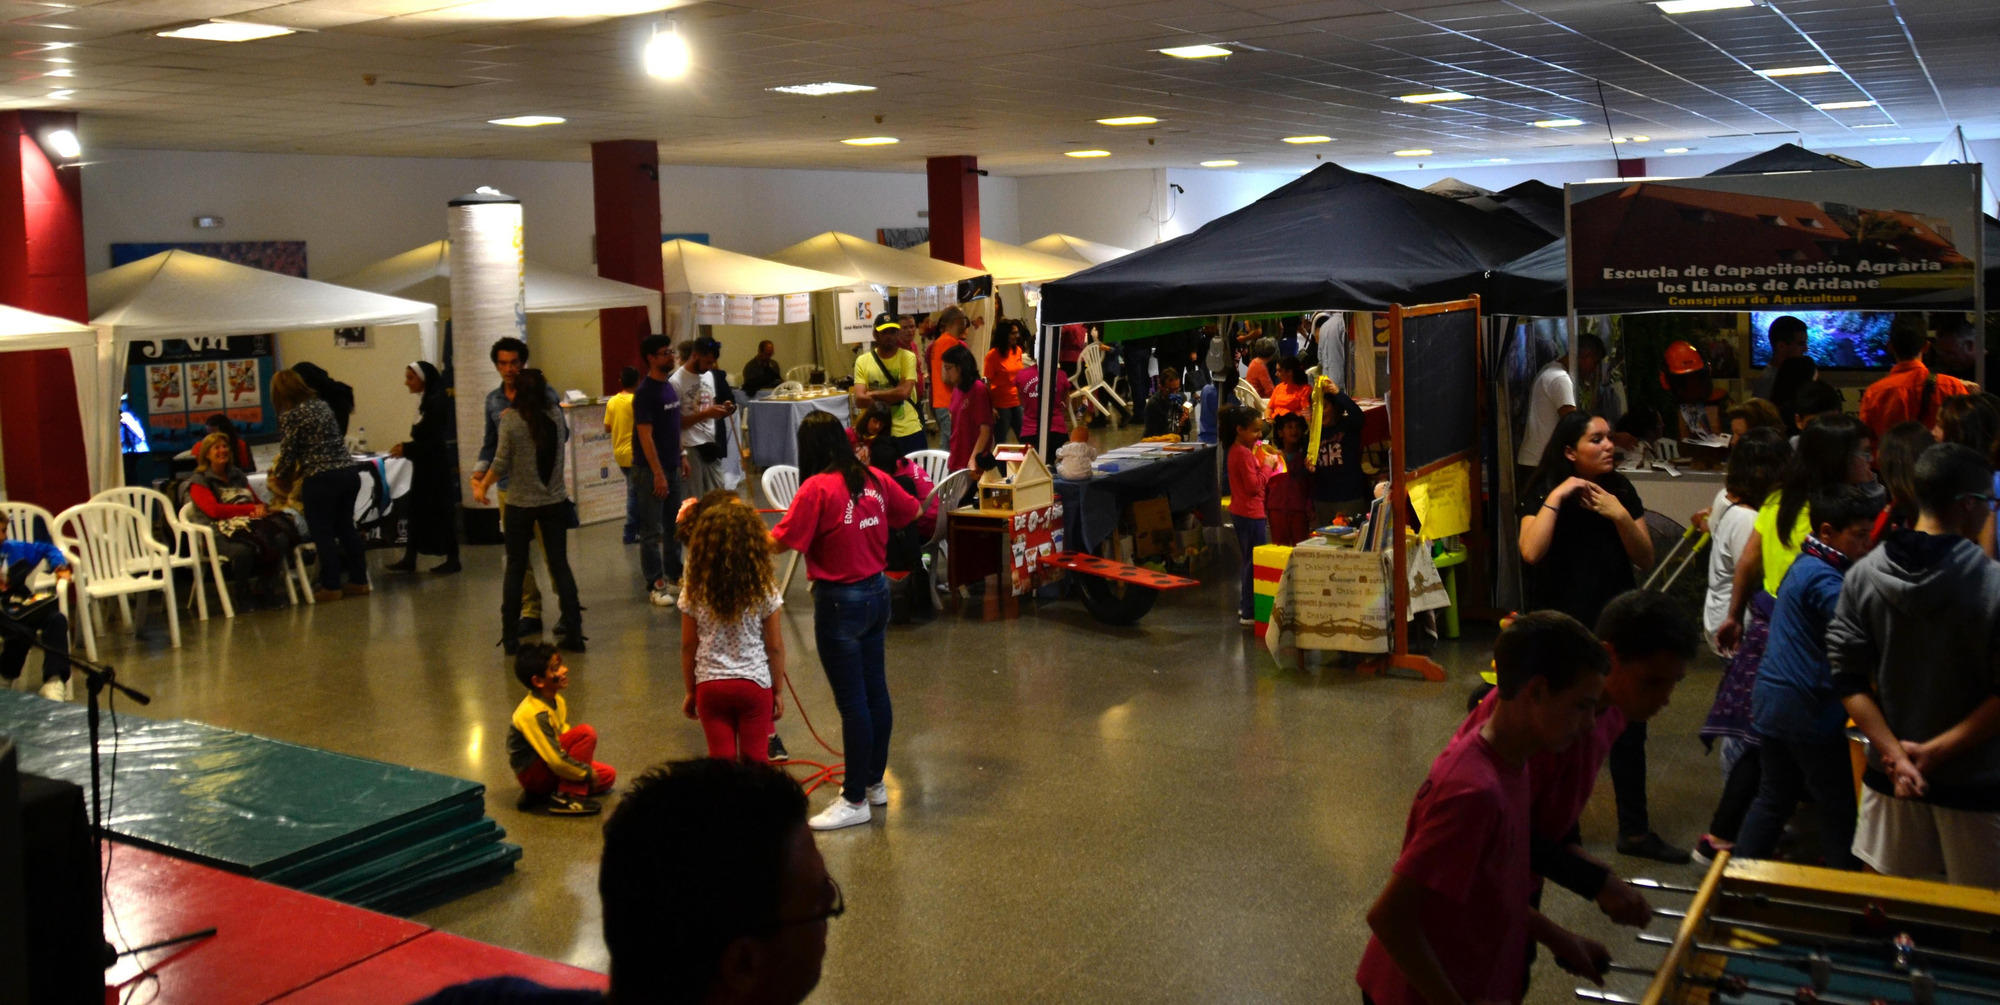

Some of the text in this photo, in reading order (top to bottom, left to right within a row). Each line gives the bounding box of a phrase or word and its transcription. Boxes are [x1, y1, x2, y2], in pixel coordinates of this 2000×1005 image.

[1603, 259, 1941, 280] Escuela de Capacitación Agraria
[1657, 277, 1880, 293] los Llanos de Aridane
[1750, 294, 1767, 304] de
[1773, 293, 1857, 305] Agricultura
